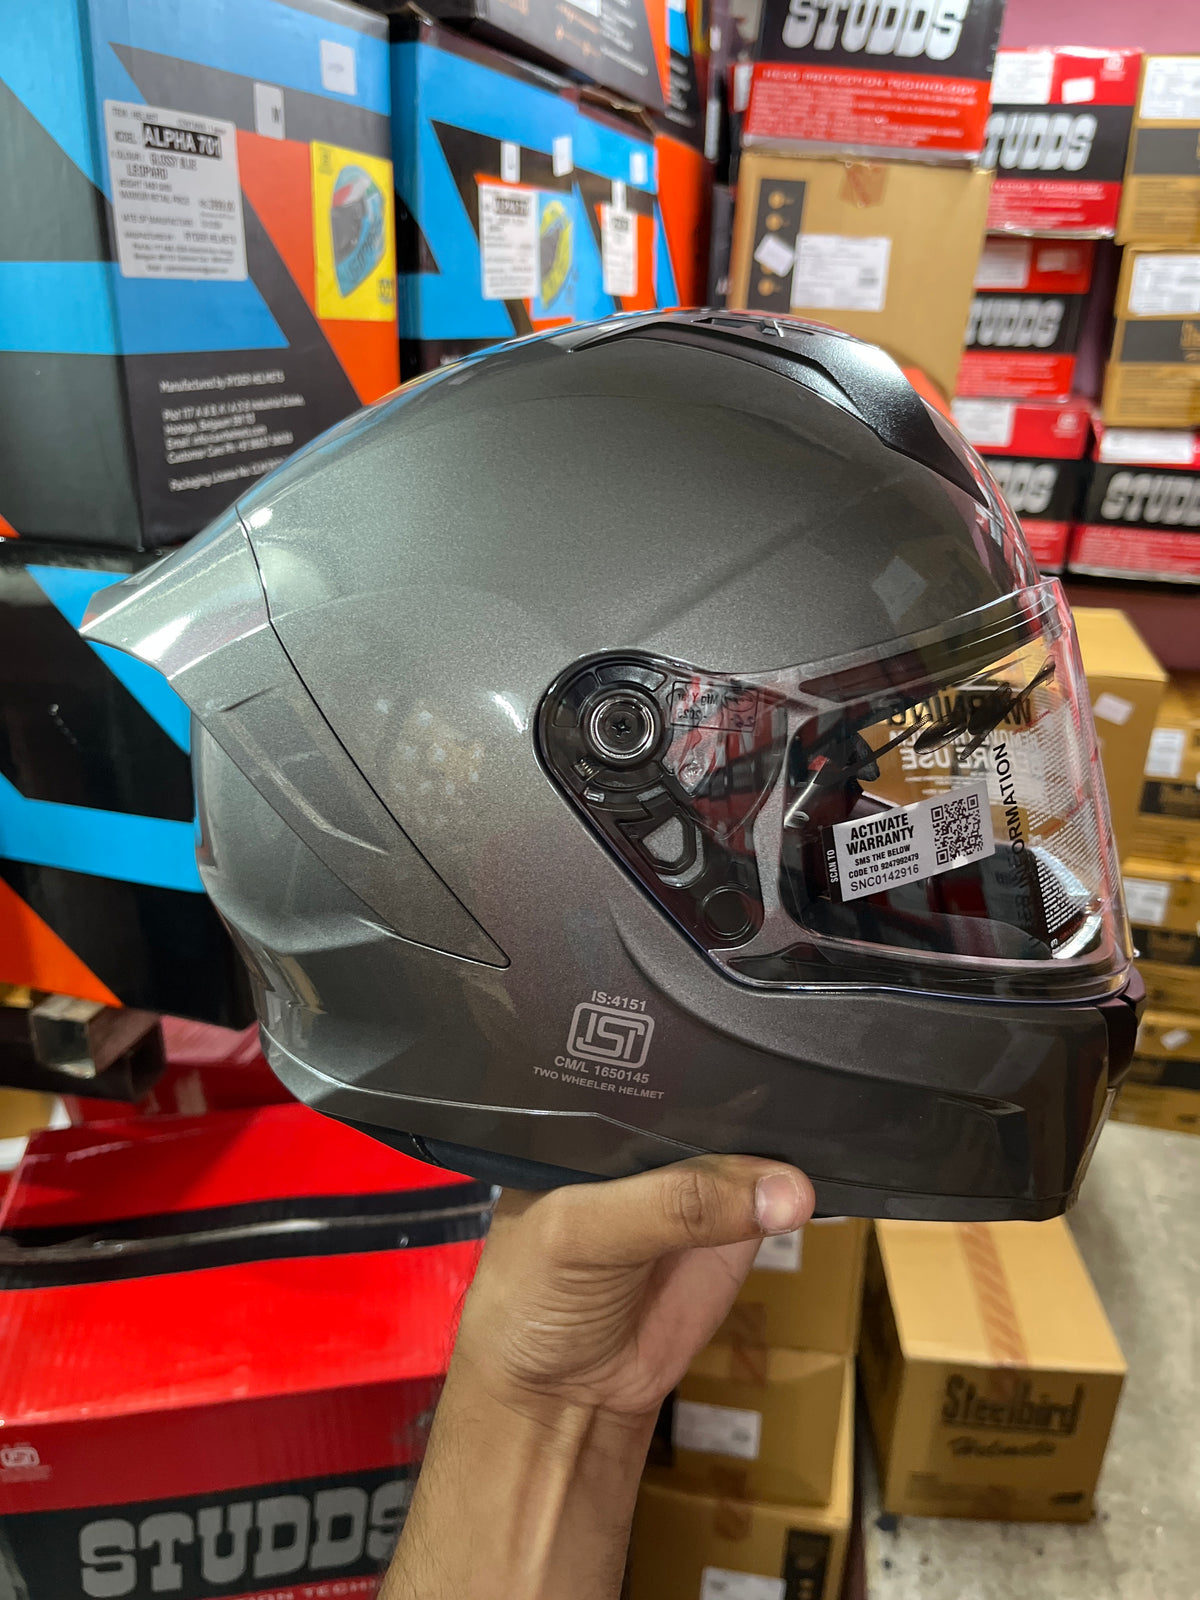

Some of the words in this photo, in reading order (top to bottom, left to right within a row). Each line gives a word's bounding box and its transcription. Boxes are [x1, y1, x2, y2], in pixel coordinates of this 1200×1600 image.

[782, 0, 969, 60] STUDDS
[144, 125, 196, 153] ALPHA
[197, 134, 221, 157] 701
[980, 112, 1097, 171] TUDDS
[964, 298, 1065, 347] TUDDS
[846, 825, 914, 855] WARRANTY
[850, 813, 909, 841] ACTIVATE
[826, 849, 835, 860] TO
[854, 856, 871, 867] SMS
[872, 852, 886, 863] THE
[887, 844, 911, 859] BELOW
[830, 862, 839, 883] SCAN
[848, 868, 868, 879] CODE
[869, 864, 879, 874] TO
[850, 863, 920, 891] SNC0142916
[591, 990, 647, 1012] IS:4151
[532, 1066, 559, 1080] TWO
[561, 1073, 616, 1093] WHEELER
[618, 1086, 665, 1100] HELMET
[554, 1055, 589, 1073] CM/L
[594, 1065, 650, 1084] 1650145
[79, 1480, 407, 1599] STUDDS
